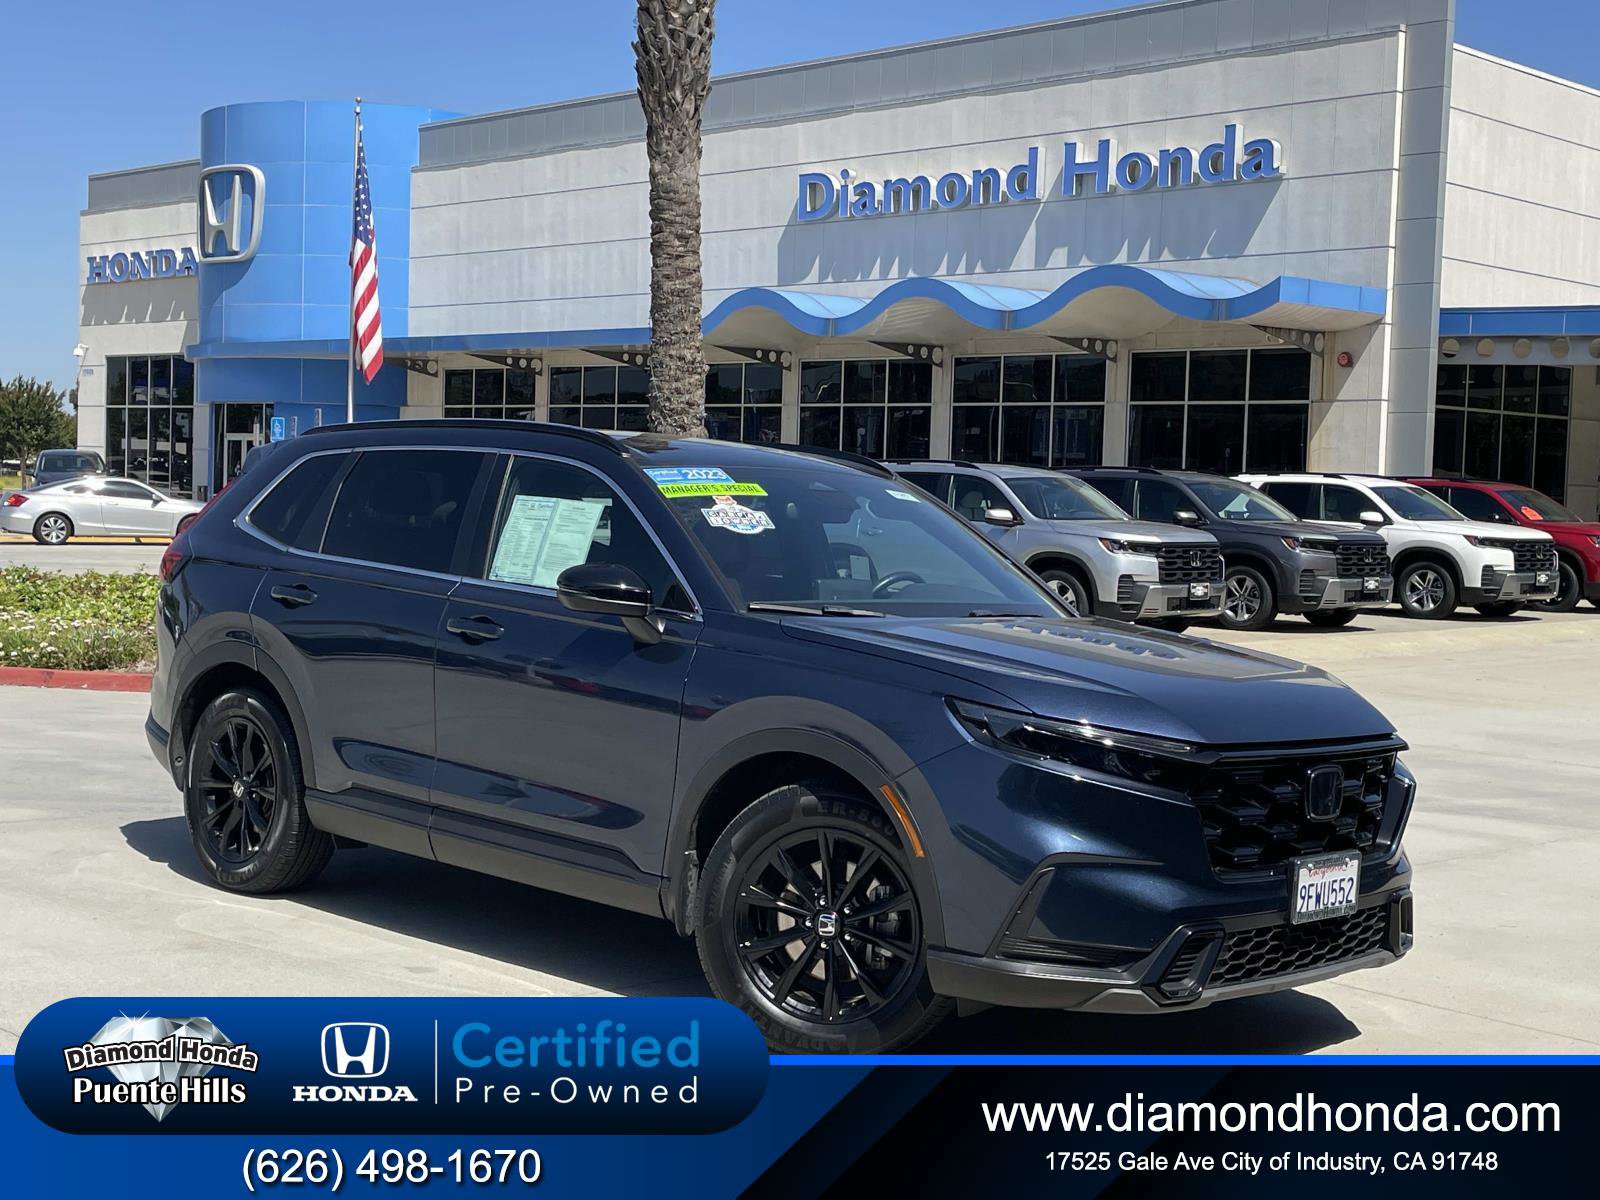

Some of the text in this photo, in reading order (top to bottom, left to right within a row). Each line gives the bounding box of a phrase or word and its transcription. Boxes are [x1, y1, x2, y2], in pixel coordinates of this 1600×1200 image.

[798, 123, 1283, 221] Diamond Honda
[86, 246, 199, 285] HONDA
[661, 483, 762, 494] MANAGER'S SPECIAL
[682, 469, 728, 480] 2023
[1299, 877, 1355, 912] 9FWU552
